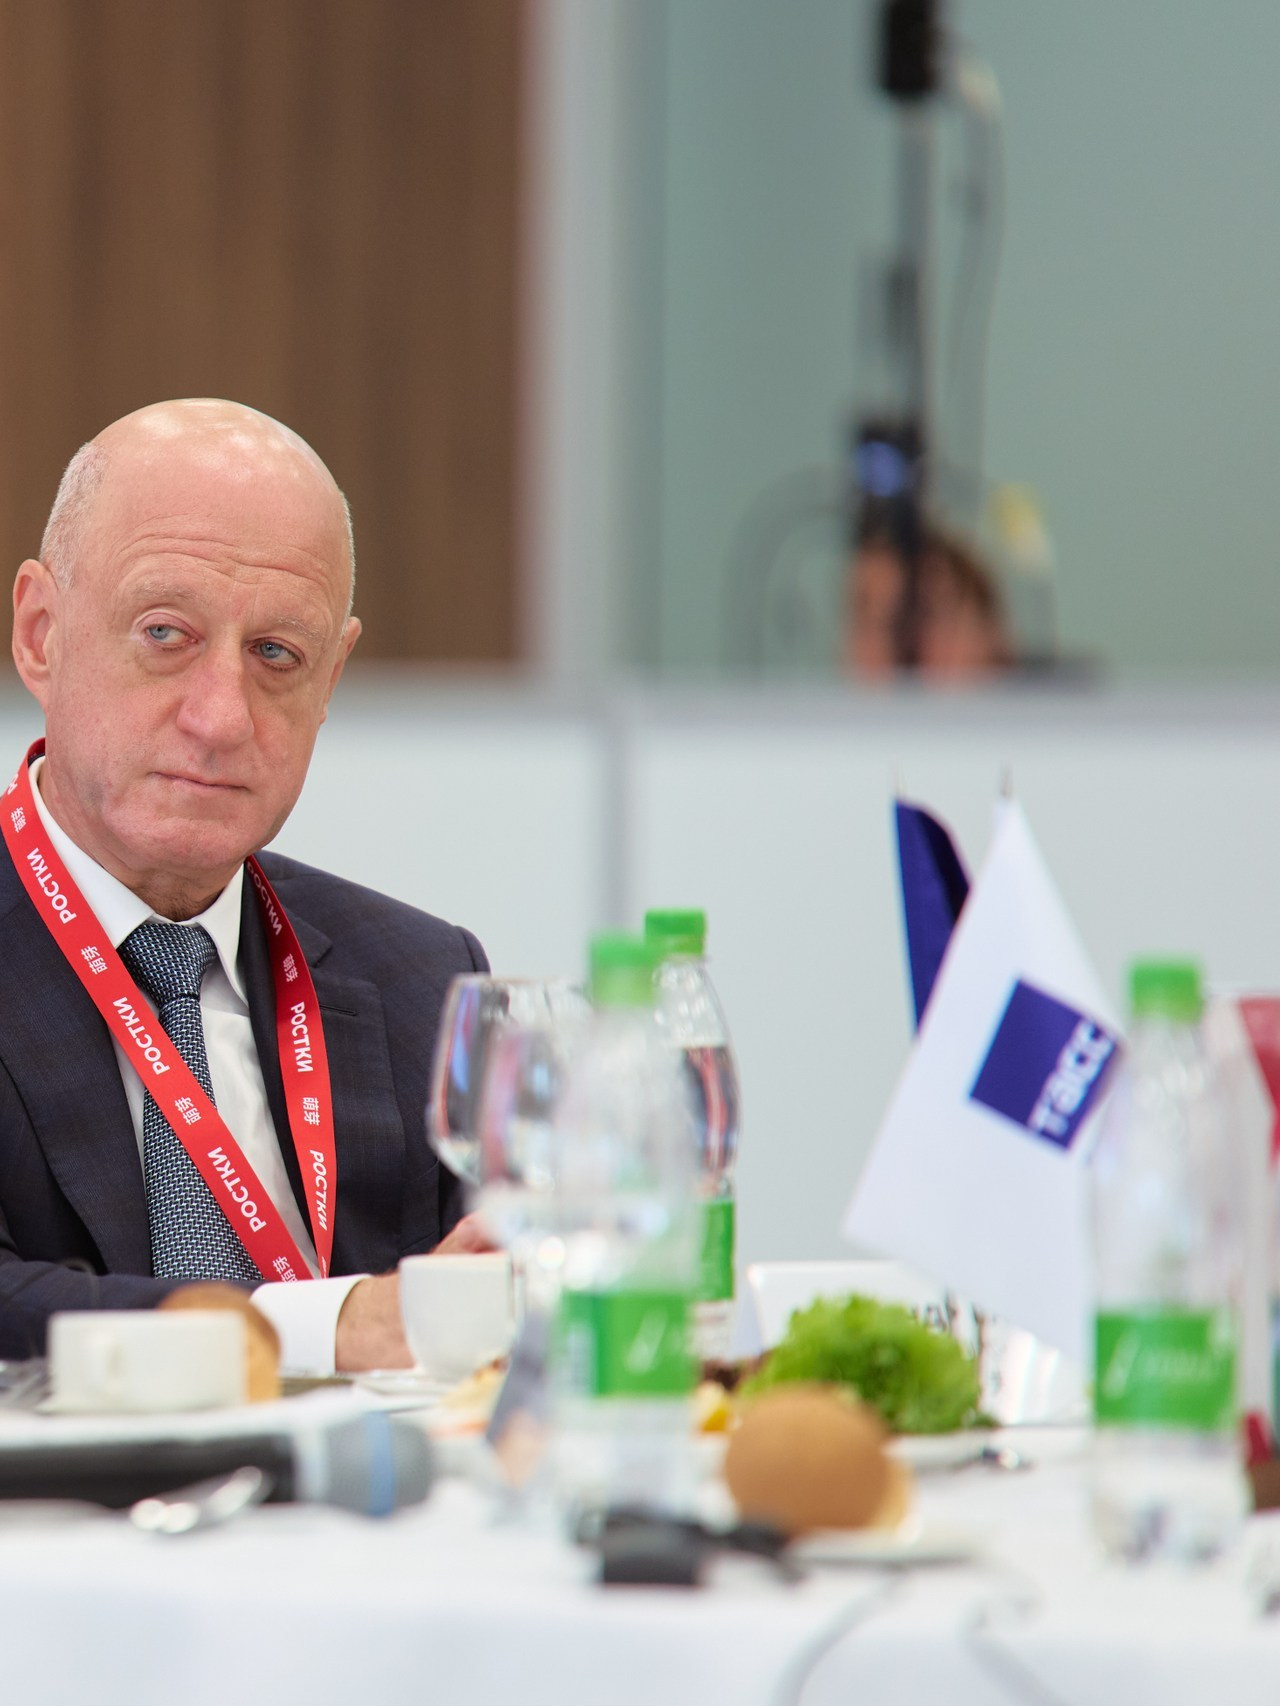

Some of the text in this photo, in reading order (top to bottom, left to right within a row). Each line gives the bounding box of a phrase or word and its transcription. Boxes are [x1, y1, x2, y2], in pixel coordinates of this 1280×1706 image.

[26, 847, 77, 925] РОСТКИ
[246, 860, 283, 936] РОСТКИ
[81, 945, 108, 975] 萌芽
[282, 953, 299, 983] 萌芽
[112, 996, 171, 1076] РОСТКИ
[290, 1001, 314, 1073] РОСТКИ
[174, 1096, 202, 1126] 萌芽
[302, 1096, 321, 1126] 萌芽
[207, 1146, 267, 1233] РОСТКИ
[309, 1149, 328, 1232] РОСТКИ
